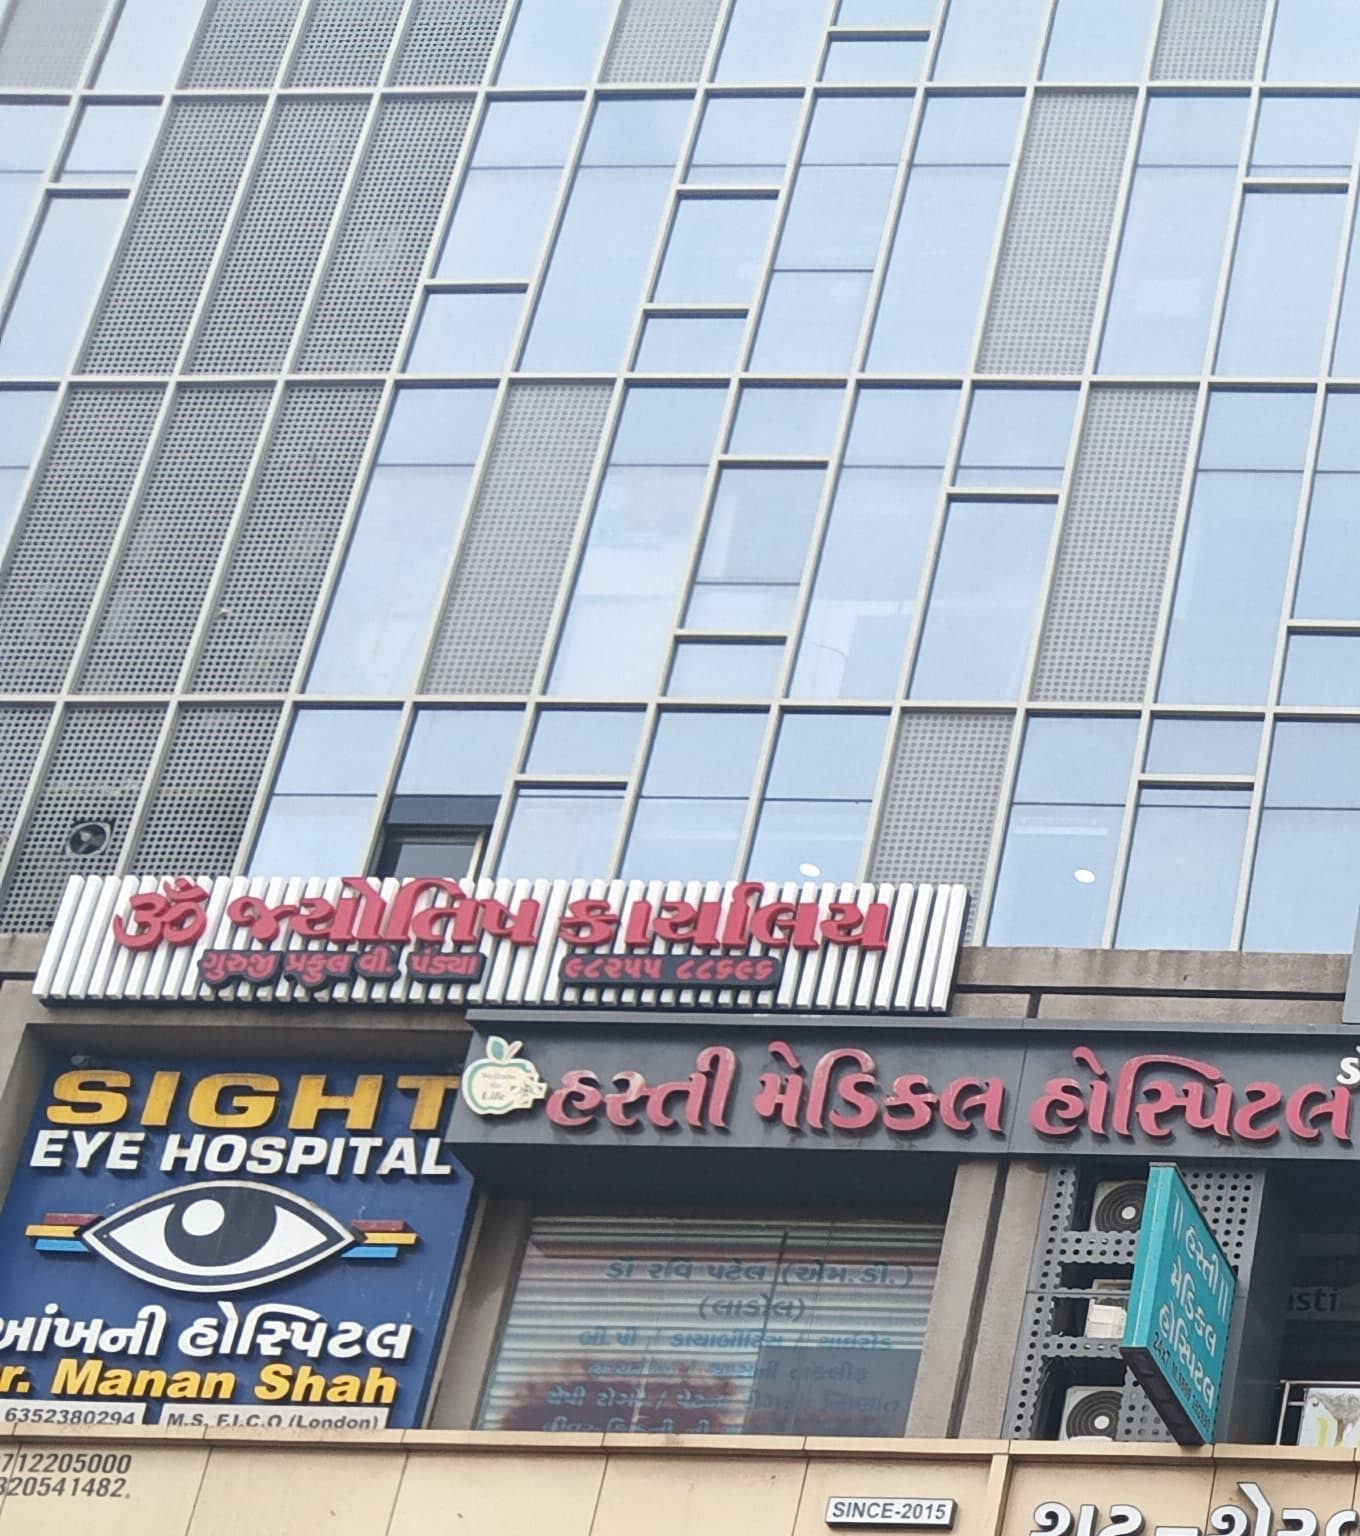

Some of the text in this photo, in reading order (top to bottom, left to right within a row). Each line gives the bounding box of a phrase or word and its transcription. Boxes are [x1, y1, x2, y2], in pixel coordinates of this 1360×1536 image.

[46, 1069, 460, 1131] SIGHT
[1030, 1045, 1352, 1142] હોસ્પિટલ
[29, 1129, 453, 1175] EYE HOSPITAL
[51, 1359, 397, 1404] Manan Shah
[831, 1501, 947, 1521] SINCE-2015
